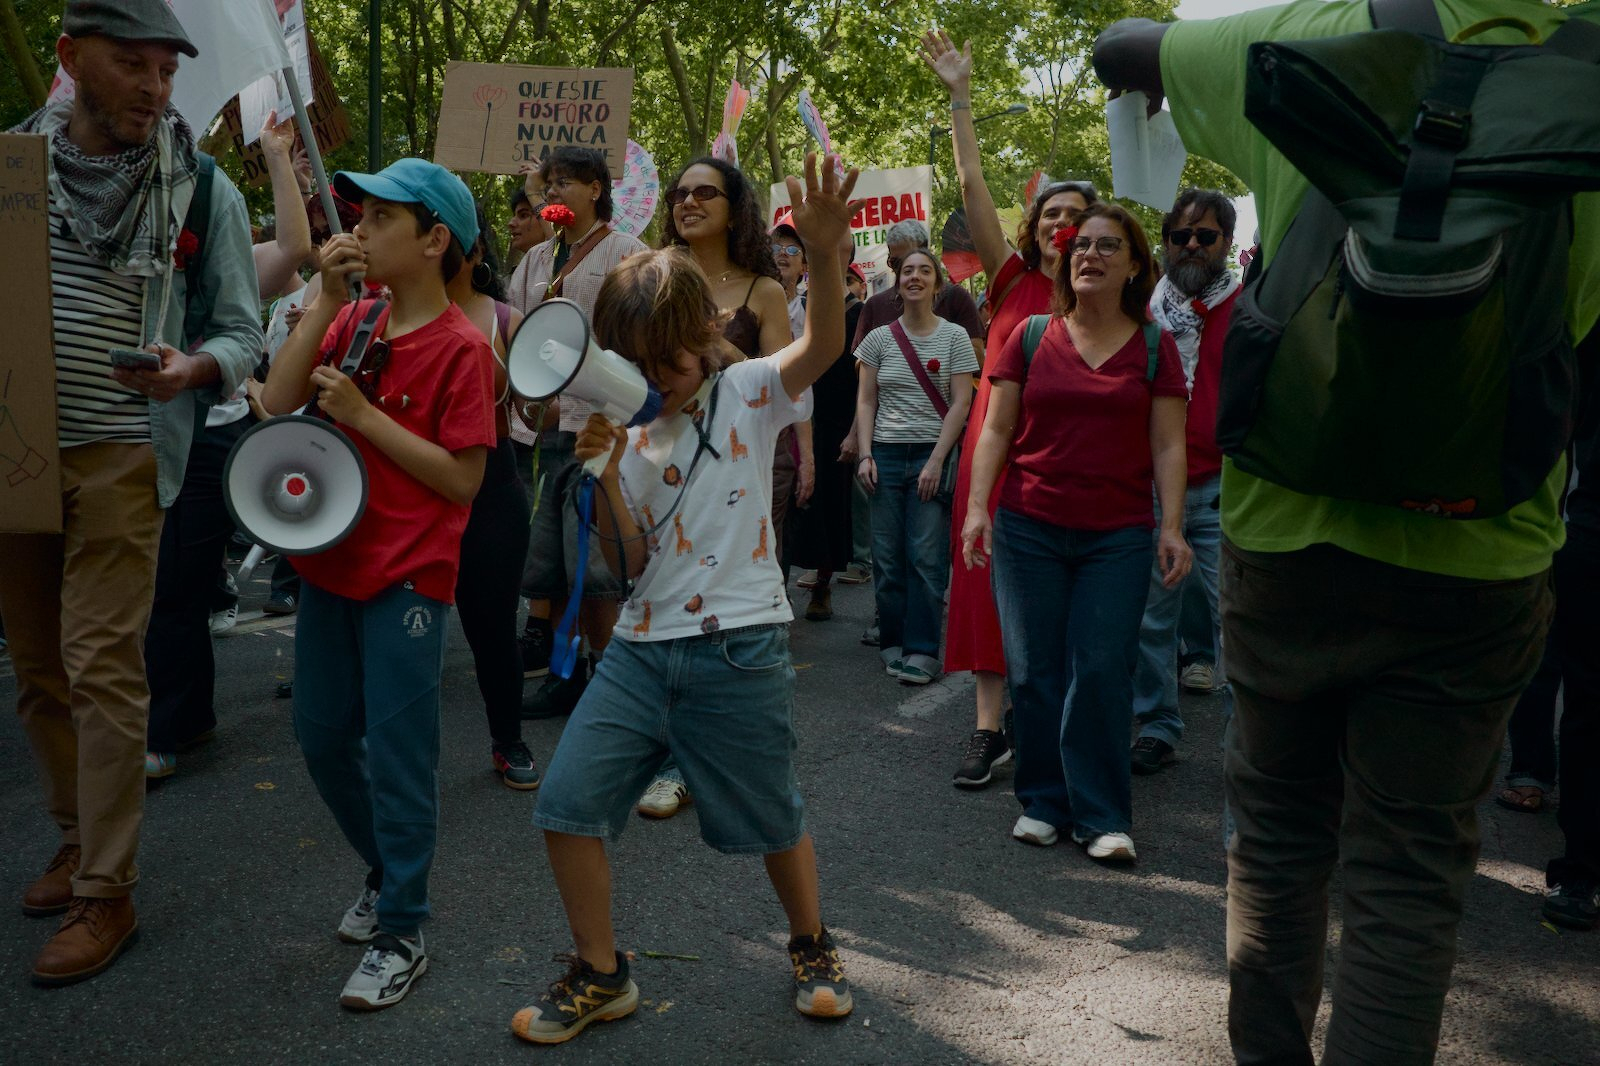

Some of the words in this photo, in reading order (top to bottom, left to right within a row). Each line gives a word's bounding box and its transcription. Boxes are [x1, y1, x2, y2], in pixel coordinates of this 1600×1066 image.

[518, 81, 553, 99] QUE
[556, 80, 608, 100] ESTE
[517, 123, 606, 144] NUNCA
